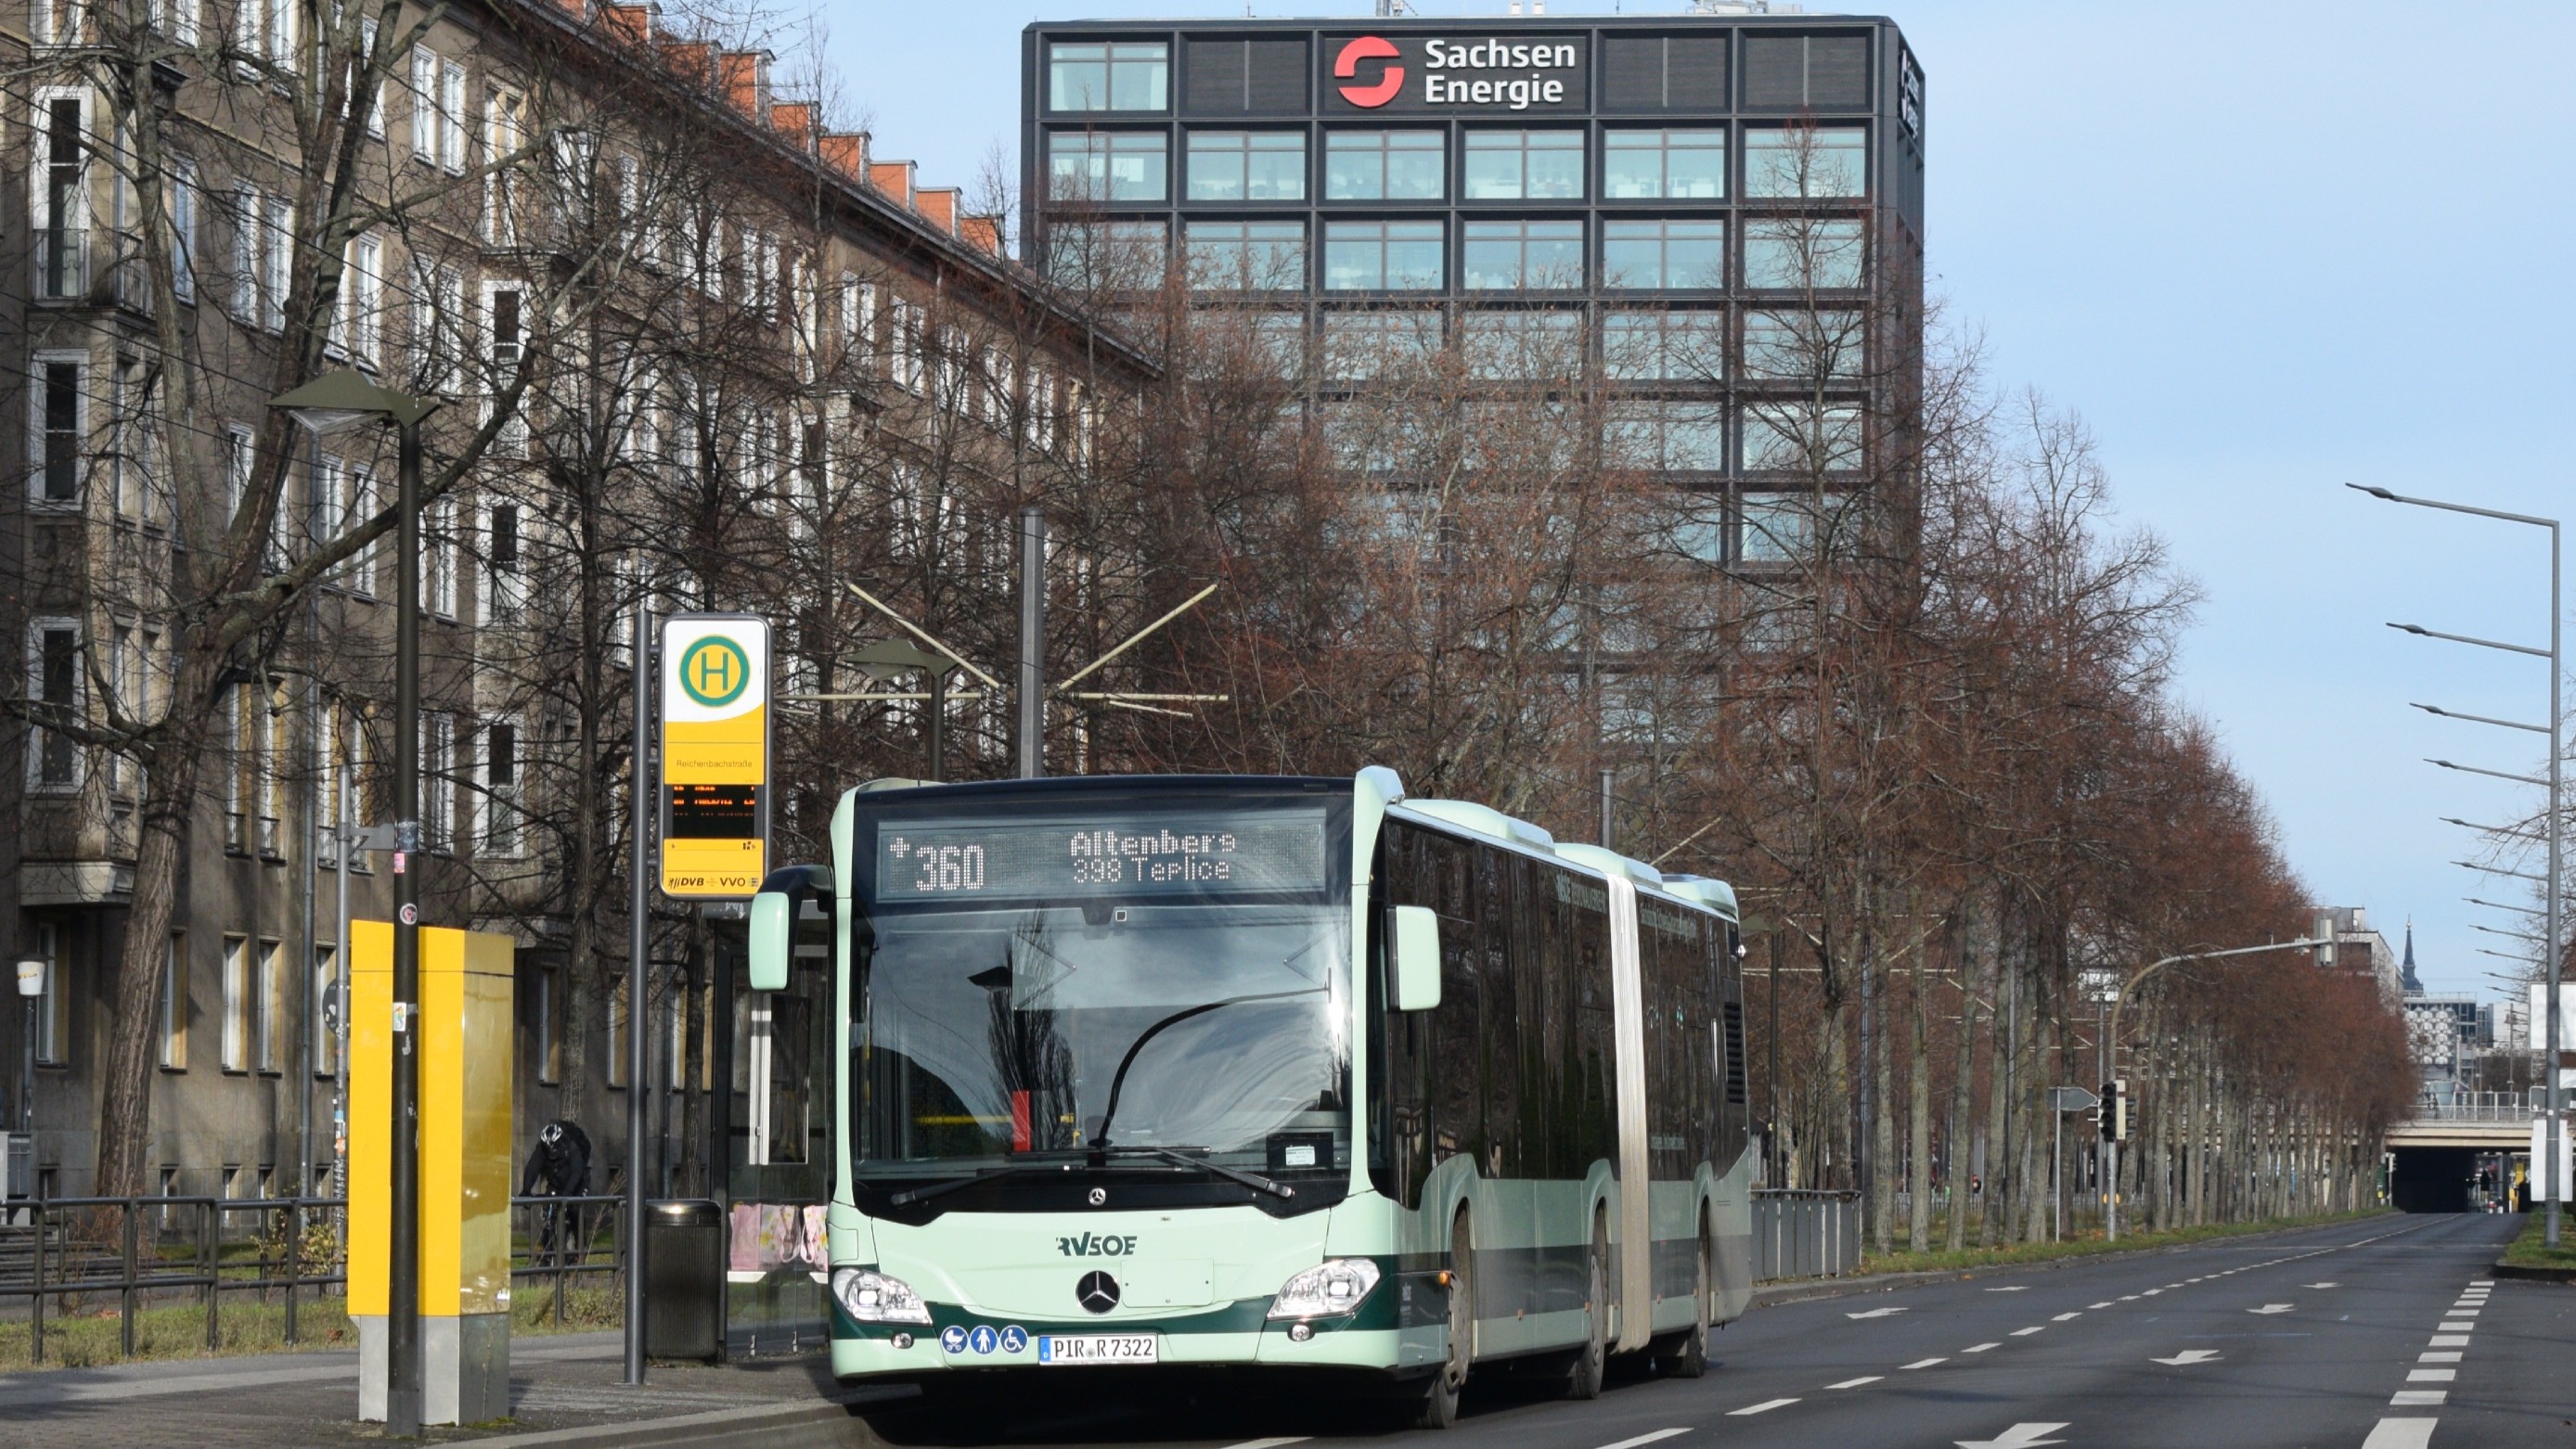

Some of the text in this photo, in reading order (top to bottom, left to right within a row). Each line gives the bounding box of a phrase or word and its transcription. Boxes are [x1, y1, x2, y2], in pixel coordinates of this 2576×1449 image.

[1425, 39, 1576, 69] Sachsen
[1425, 73, 1564, 110] Energie
[701, 652, 729, 691] H
[676, 759, 753, 768] Reichenbachstraße
[916, 844, 984, 891] 360
[1073, 855, 1230, 883] 398 Teplice
[680, 877, 746, 887] DVB VVO
[1056, 1231, 1138, 1257] RVSOE
[1054, 1340, 1085, 1358] PIR
[1097, 1339, 1106, 1357] R
[1112, 1339, 1153, 1357] 7322
